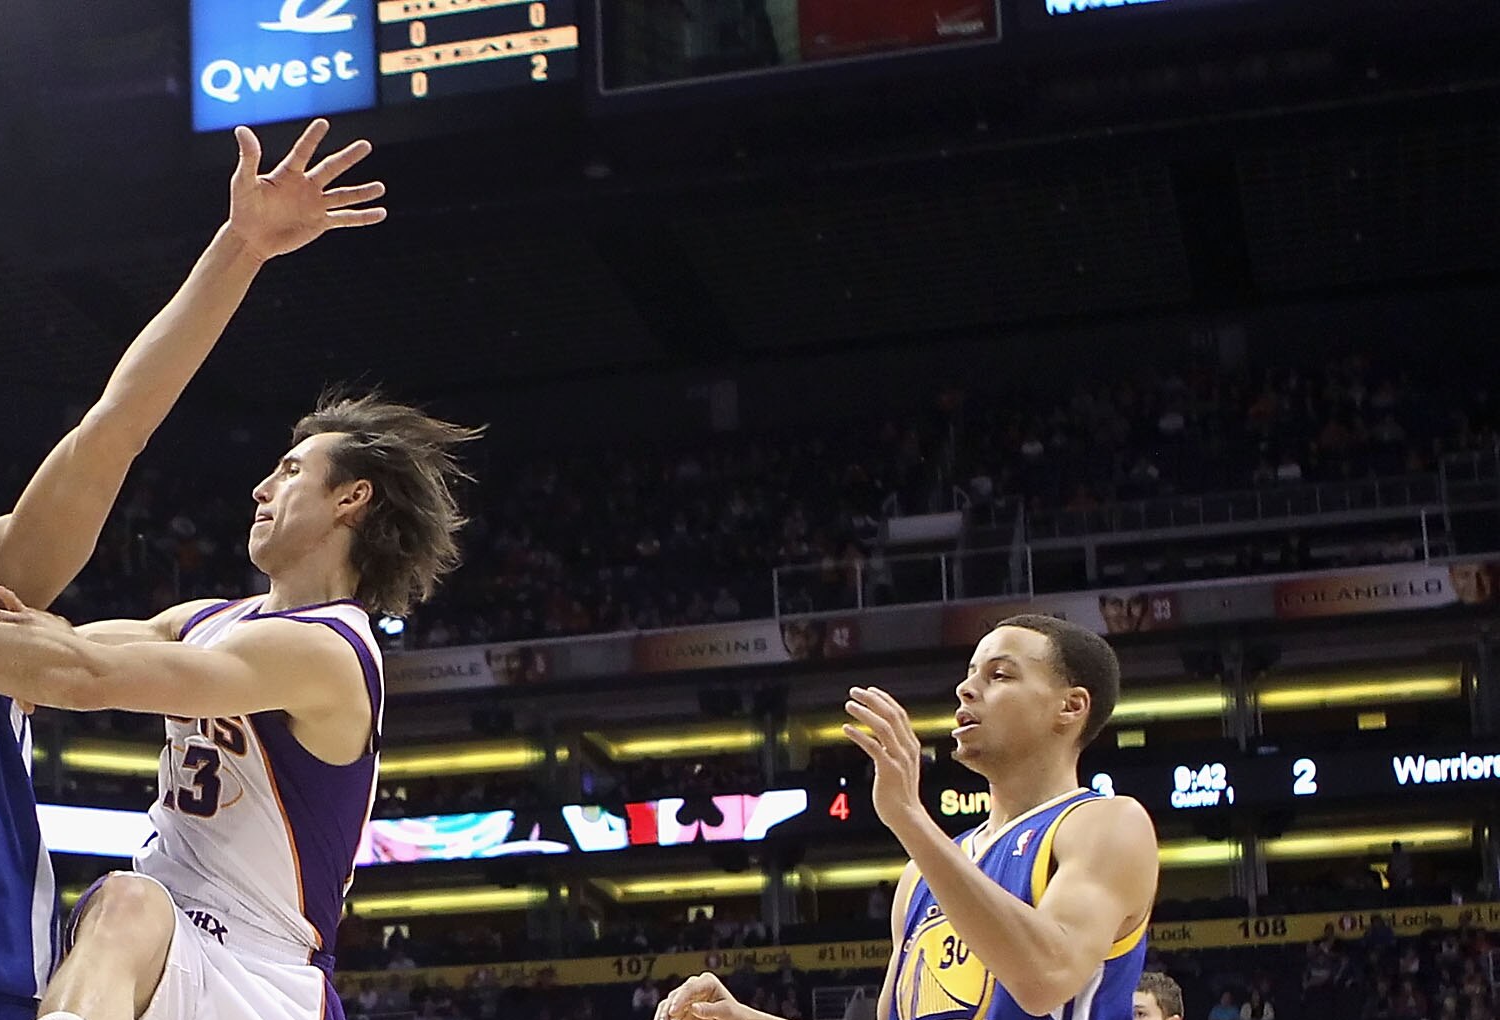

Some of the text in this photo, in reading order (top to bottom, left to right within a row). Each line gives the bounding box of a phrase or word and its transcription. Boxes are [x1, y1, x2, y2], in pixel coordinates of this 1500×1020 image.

[529, 2, 546, 27] 0
[409, 20, 427, 47] 0
[403, 37, 550, 62] STEALS
[201, 50, 358, 103] Qwest
[531, 54, 548, 81] 2
[411, 71, 428, 97] 0
[655, 638, 766, 657] HAWKINS
[1173, 763, 1227, 791] 9:42
[1293, 758, 1317, 795] 2
[830, 794, 849, 820] 4
[940, 789, 991, 815] Sun
[1226, 786, 1234, 805] 1
[1150, 924, 1192, 941] Lock
[1238, 918, 1287, 938] 108
[939, 935, 970, 970] 30
[612, 957, 656, 977] 107
